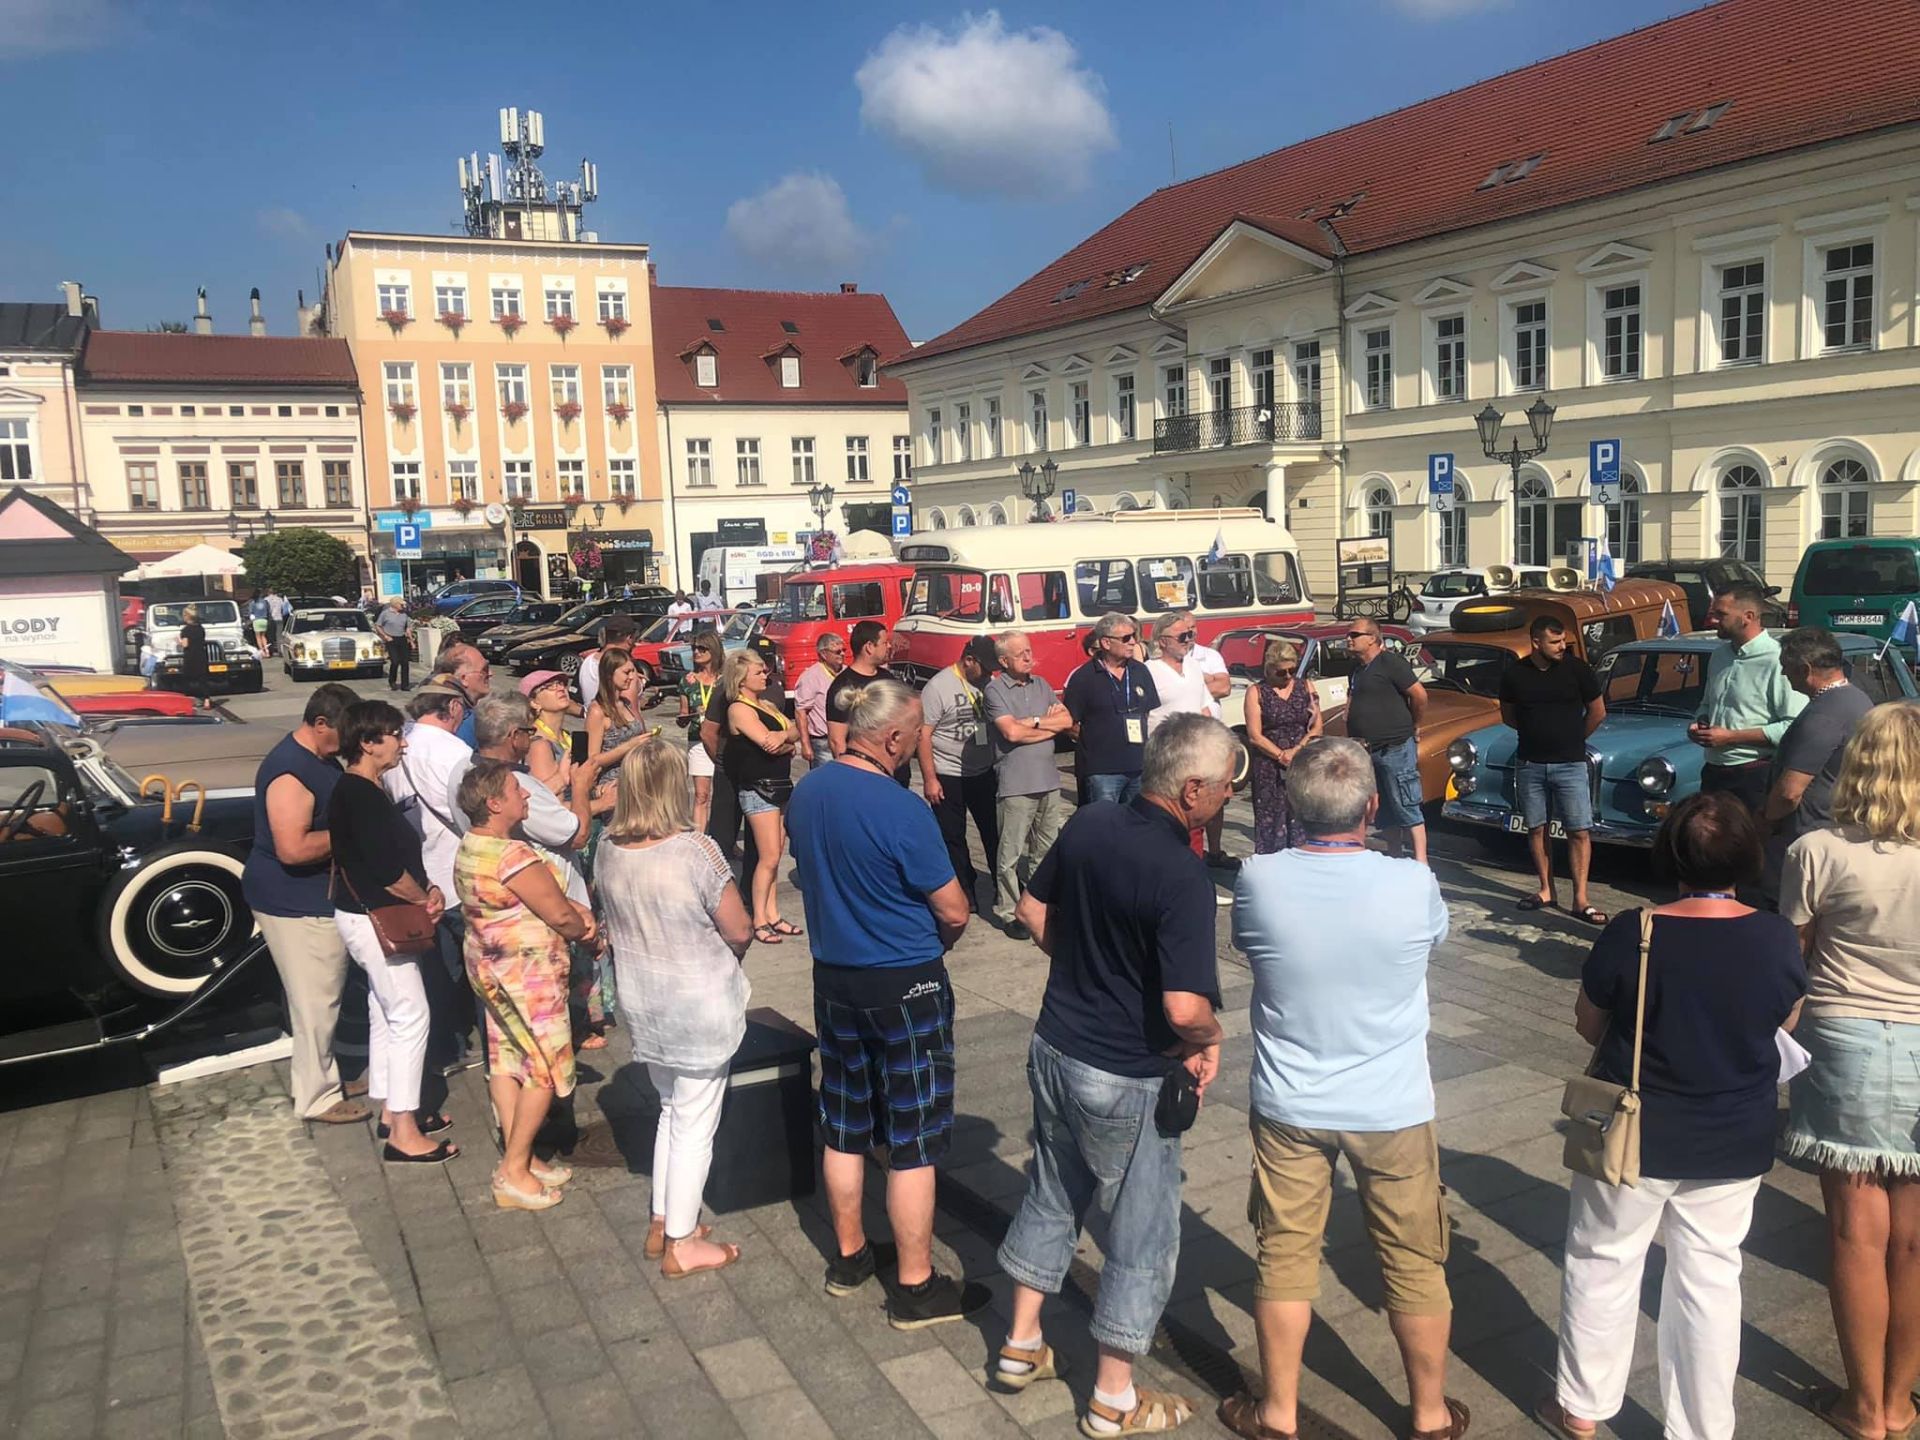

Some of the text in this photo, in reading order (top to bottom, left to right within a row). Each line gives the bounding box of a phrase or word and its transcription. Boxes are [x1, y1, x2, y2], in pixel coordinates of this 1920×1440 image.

[1596, 443, 1614, 471] P
[1434, 456, 1448, 482] P
[1065, 491, 1073, 510] P
[896, 516, 908, 532] P
[400, 526, 416, 546] P
[0, 617, 60, 634] LODY
